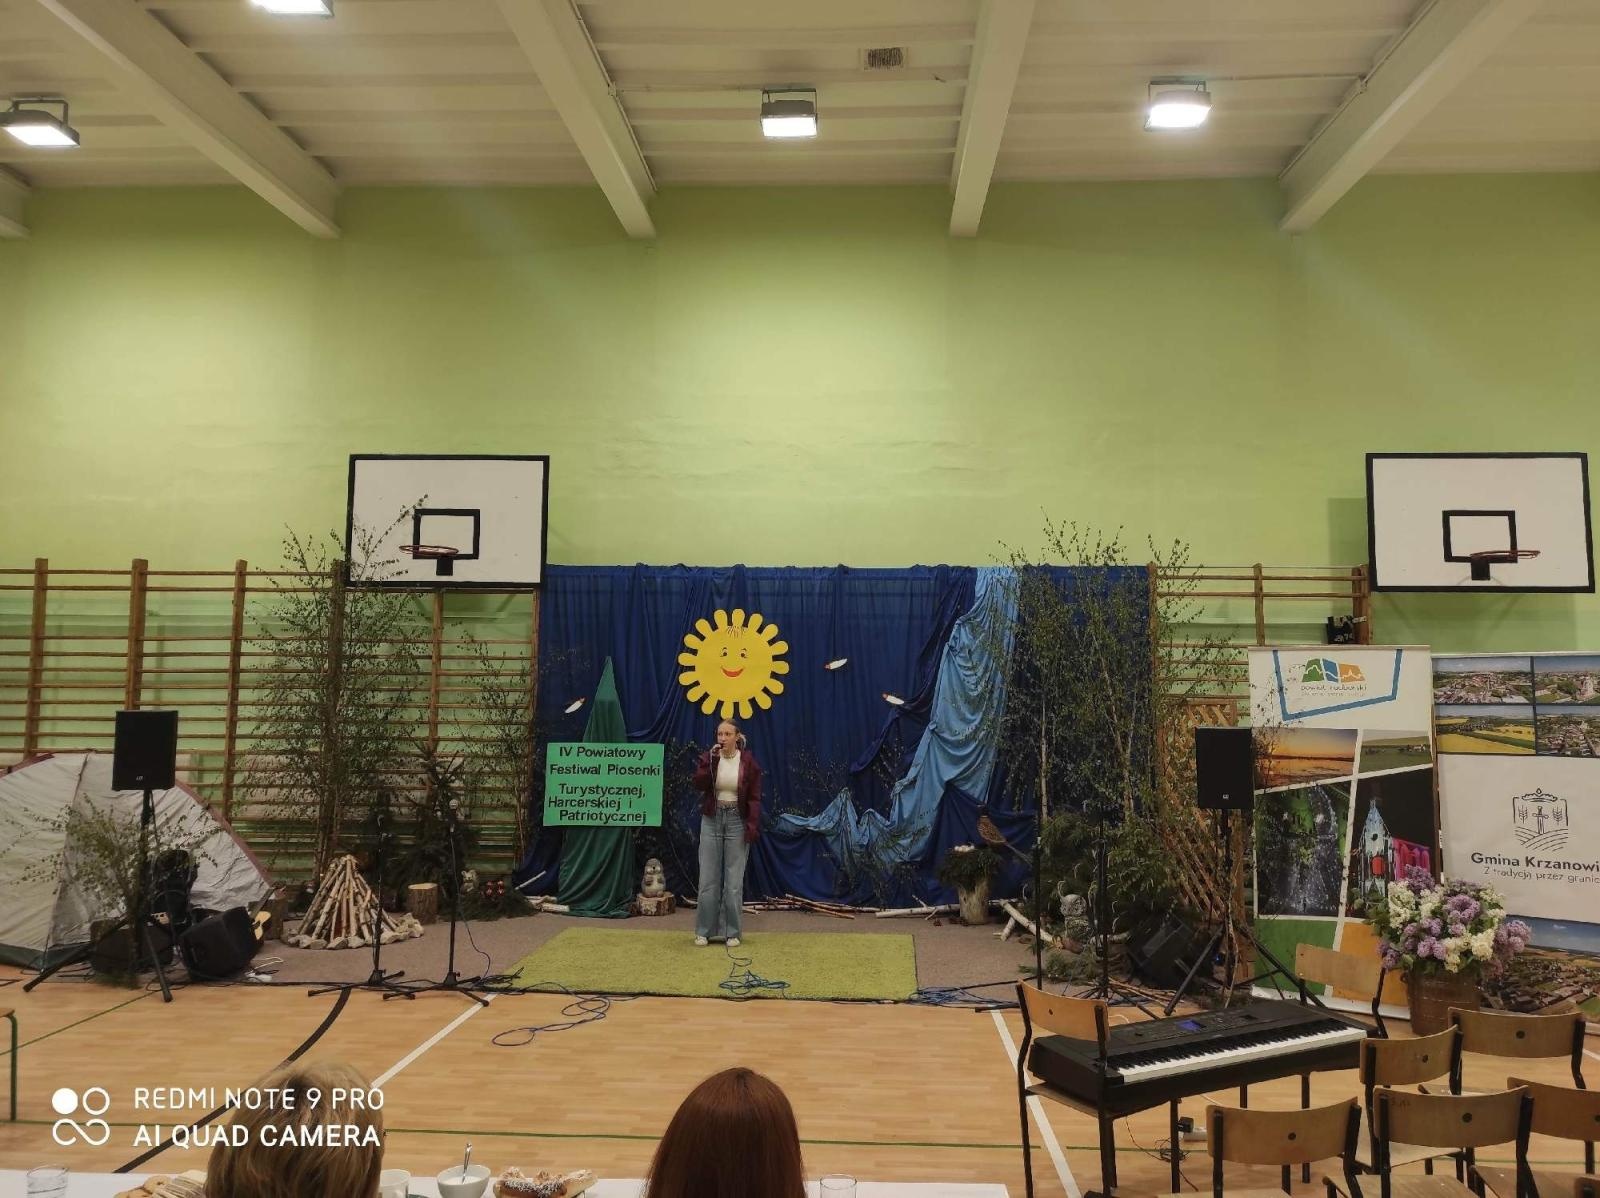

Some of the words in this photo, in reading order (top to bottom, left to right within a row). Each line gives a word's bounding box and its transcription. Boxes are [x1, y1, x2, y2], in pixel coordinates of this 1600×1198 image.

[559, 746, 572, 757] IV
[577, 746, 646, 760] Powiatowy
[550, 764, 601, 775] Festiwal
[607, 764, 661, 776] Piosenki
[559, 783, 646, 798] Turystycznej,
[548, 796, 621, 811] Harcerskiej
[628, 797, 633, 809] i
[559, 810, 647, 825] Patriotycznej
[1471, 852, 1520, 867] Gmina
